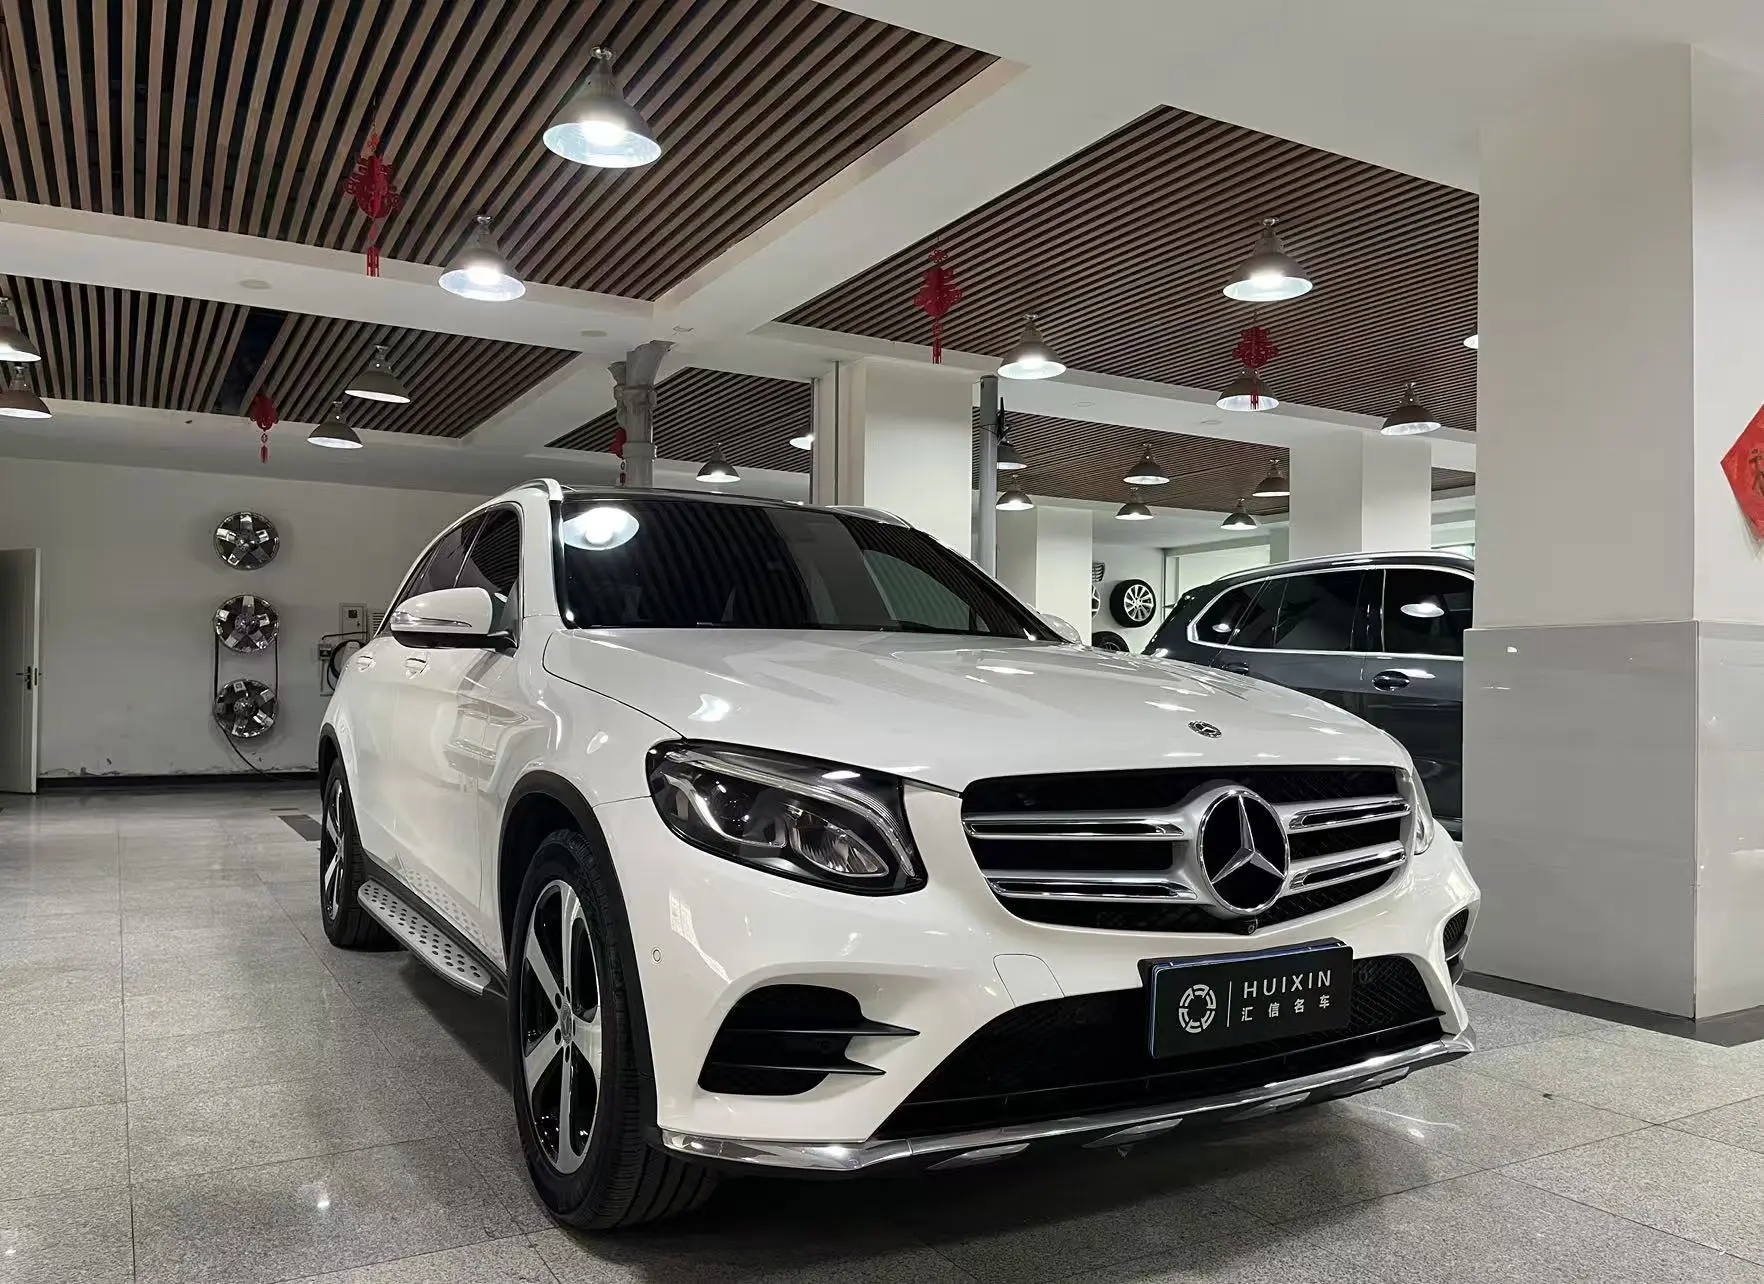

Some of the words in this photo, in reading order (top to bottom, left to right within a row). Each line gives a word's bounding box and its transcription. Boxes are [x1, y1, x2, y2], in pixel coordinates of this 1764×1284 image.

[1243, 969, 1331, 999] HUIXIN
[1241, 994, 1330, 1022] 汇信名车
